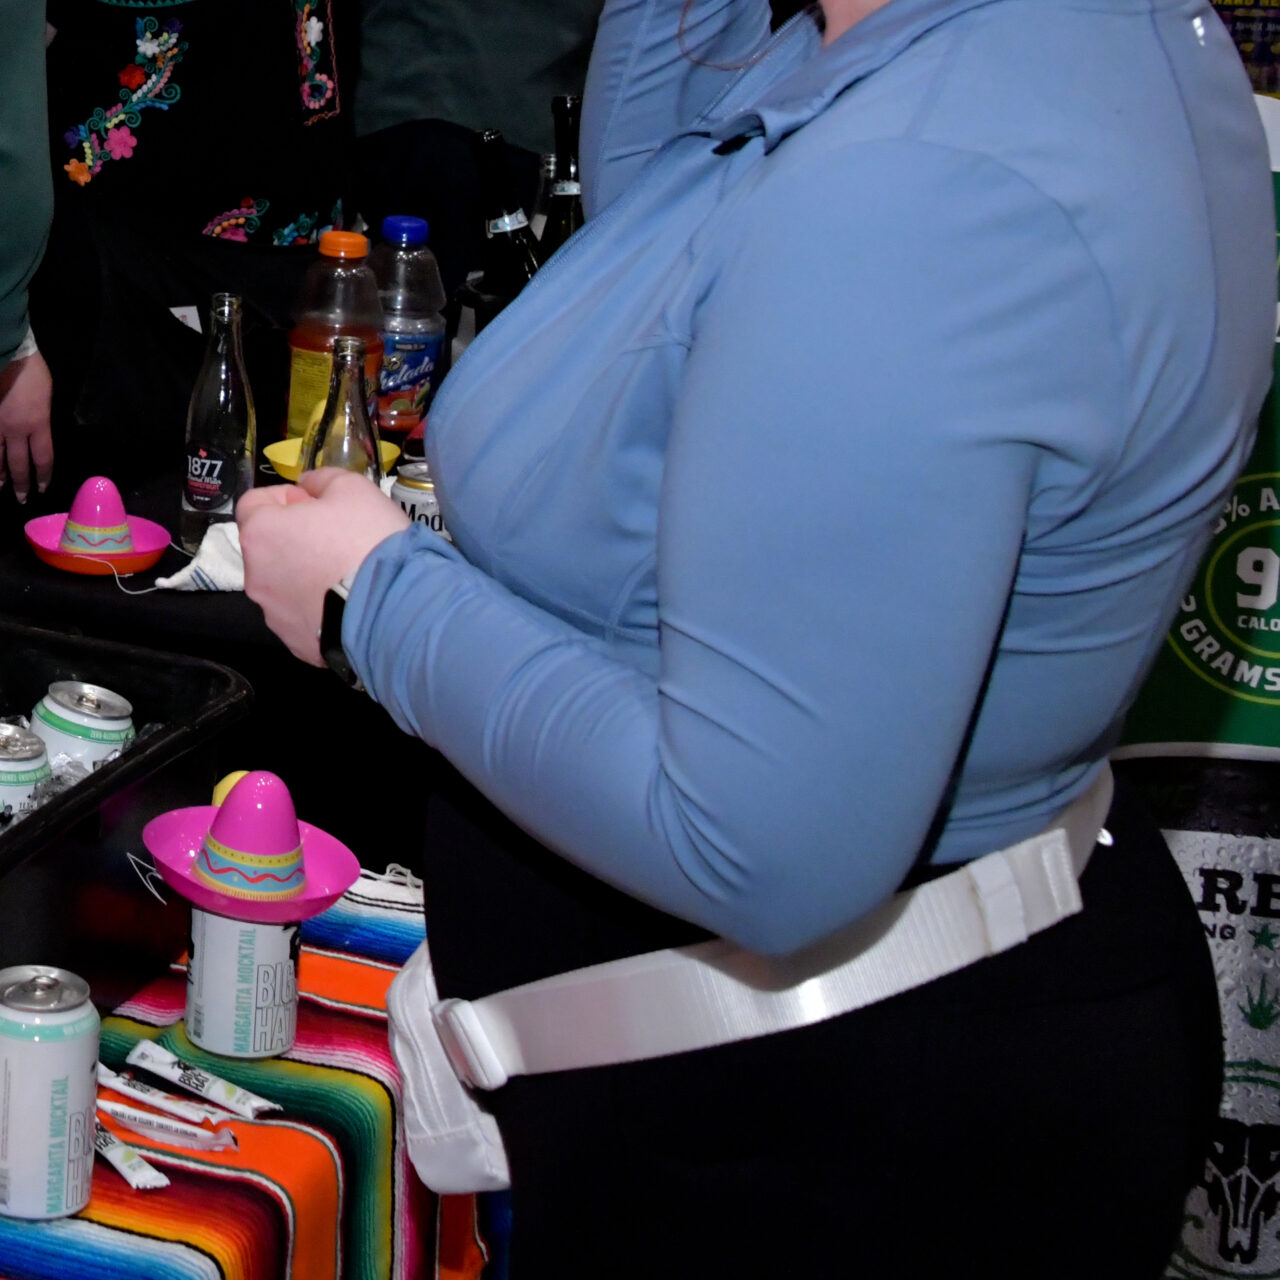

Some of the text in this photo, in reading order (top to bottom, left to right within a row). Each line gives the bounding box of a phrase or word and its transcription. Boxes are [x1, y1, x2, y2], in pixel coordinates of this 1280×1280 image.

[187, 455, 223, 478] 1877
[401, 502, 443, 532] Mod
[234, 928, 256, 1053] MARGARITA MOCKTAIL
[46, 1075, 68, 1213] MARGARITA MOCKTAIL
